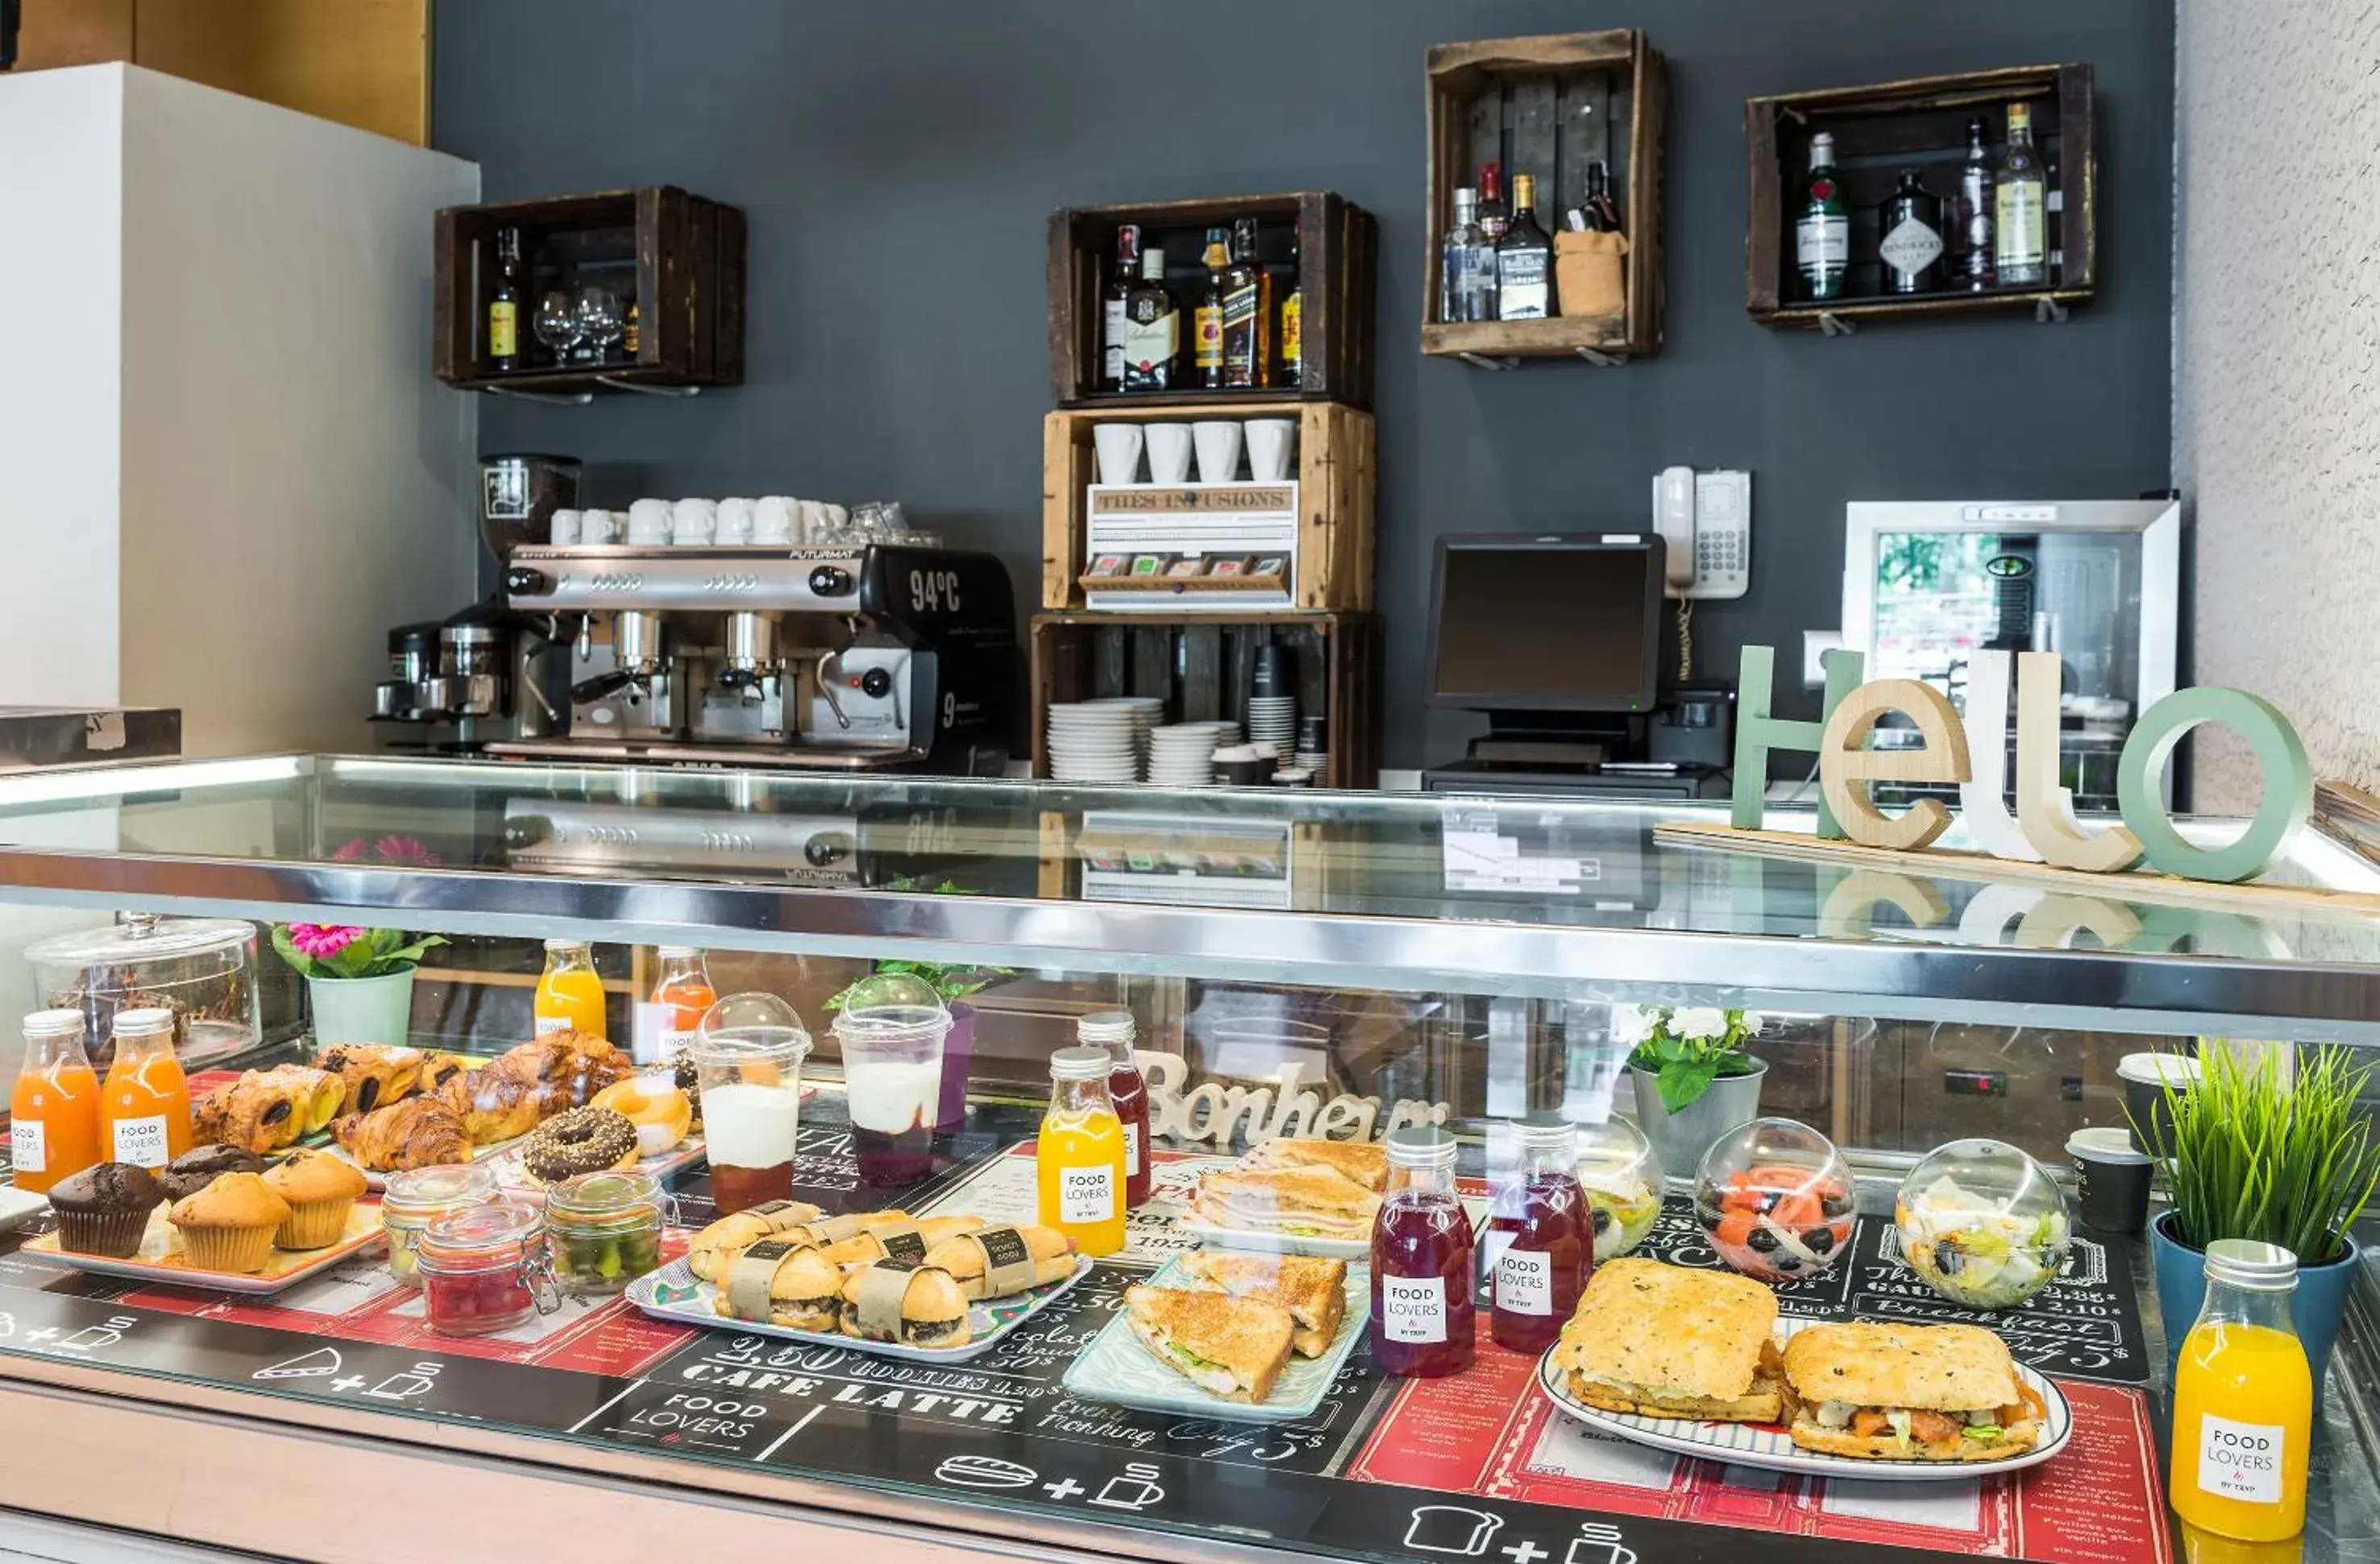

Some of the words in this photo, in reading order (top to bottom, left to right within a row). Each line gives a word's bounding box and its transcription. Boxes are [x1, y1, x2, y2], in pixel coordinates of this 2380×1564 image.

[1161, 490, 1286, 508] INFUSIONS
[790, 550, 854, 559] FUTURMAT
[943, 692, 956, 728] 9
[121, 1125, 158, 1136] FOOD
[118, 1137, 162, 1150] LOVERS
[1069, 1174, 1106, 1186] FOOD
[1065, 1187, 1109, 1201] LOVERS
[1502, 1257, 1540, 1273] FOOD
[1498, 1271, 1544, 1290] LOVERS
[1392, 1288, 1435, 1301] FOOD
[1389, 1303, 1439, 1317] LOVERS
[683, 1364, 824, 1397] CAFE
[832, 1384, 1024, 1424] LATTE
[665, 1394, 767, 1418] FOOD
[630, 1408, 756, 1438] LOVERS
[2214, 1429, 2270, 1451] FOOD
[2207, 1447, 2274, 1471] LOVERS
[2220, 1480, 2232, 1488] BY
[2233, 1483, 2256, 1492] TRYP
